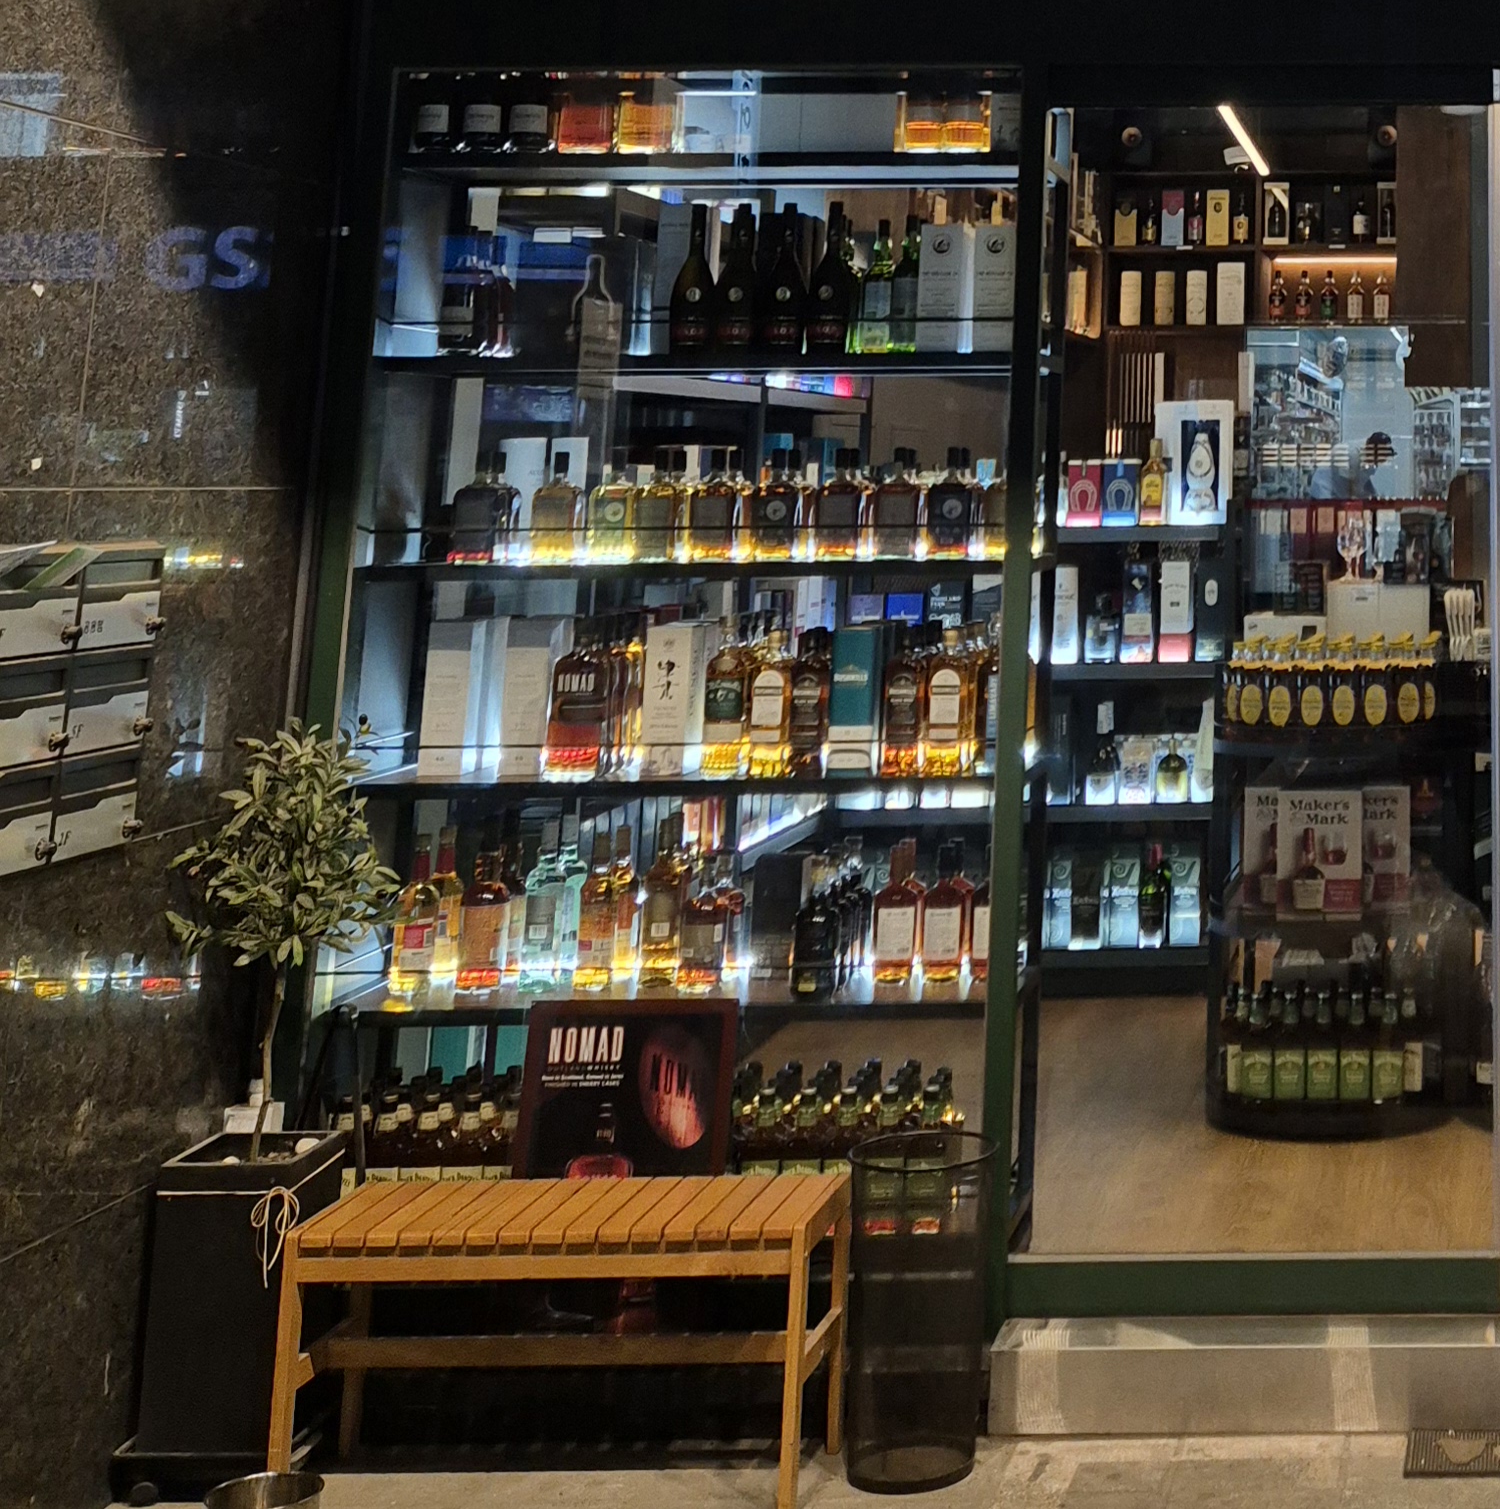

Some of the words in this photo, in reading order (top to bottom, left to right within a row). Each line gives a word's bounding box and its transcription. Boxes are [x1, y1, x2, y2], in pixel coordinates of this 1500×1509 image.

[557, 674, 595, 692] NOMAD
[1290, 799, 1350, 812] Maker's
[1305, 813, 1348, 825] Mark
[547, 1026, 624, 1064] NOMAD
